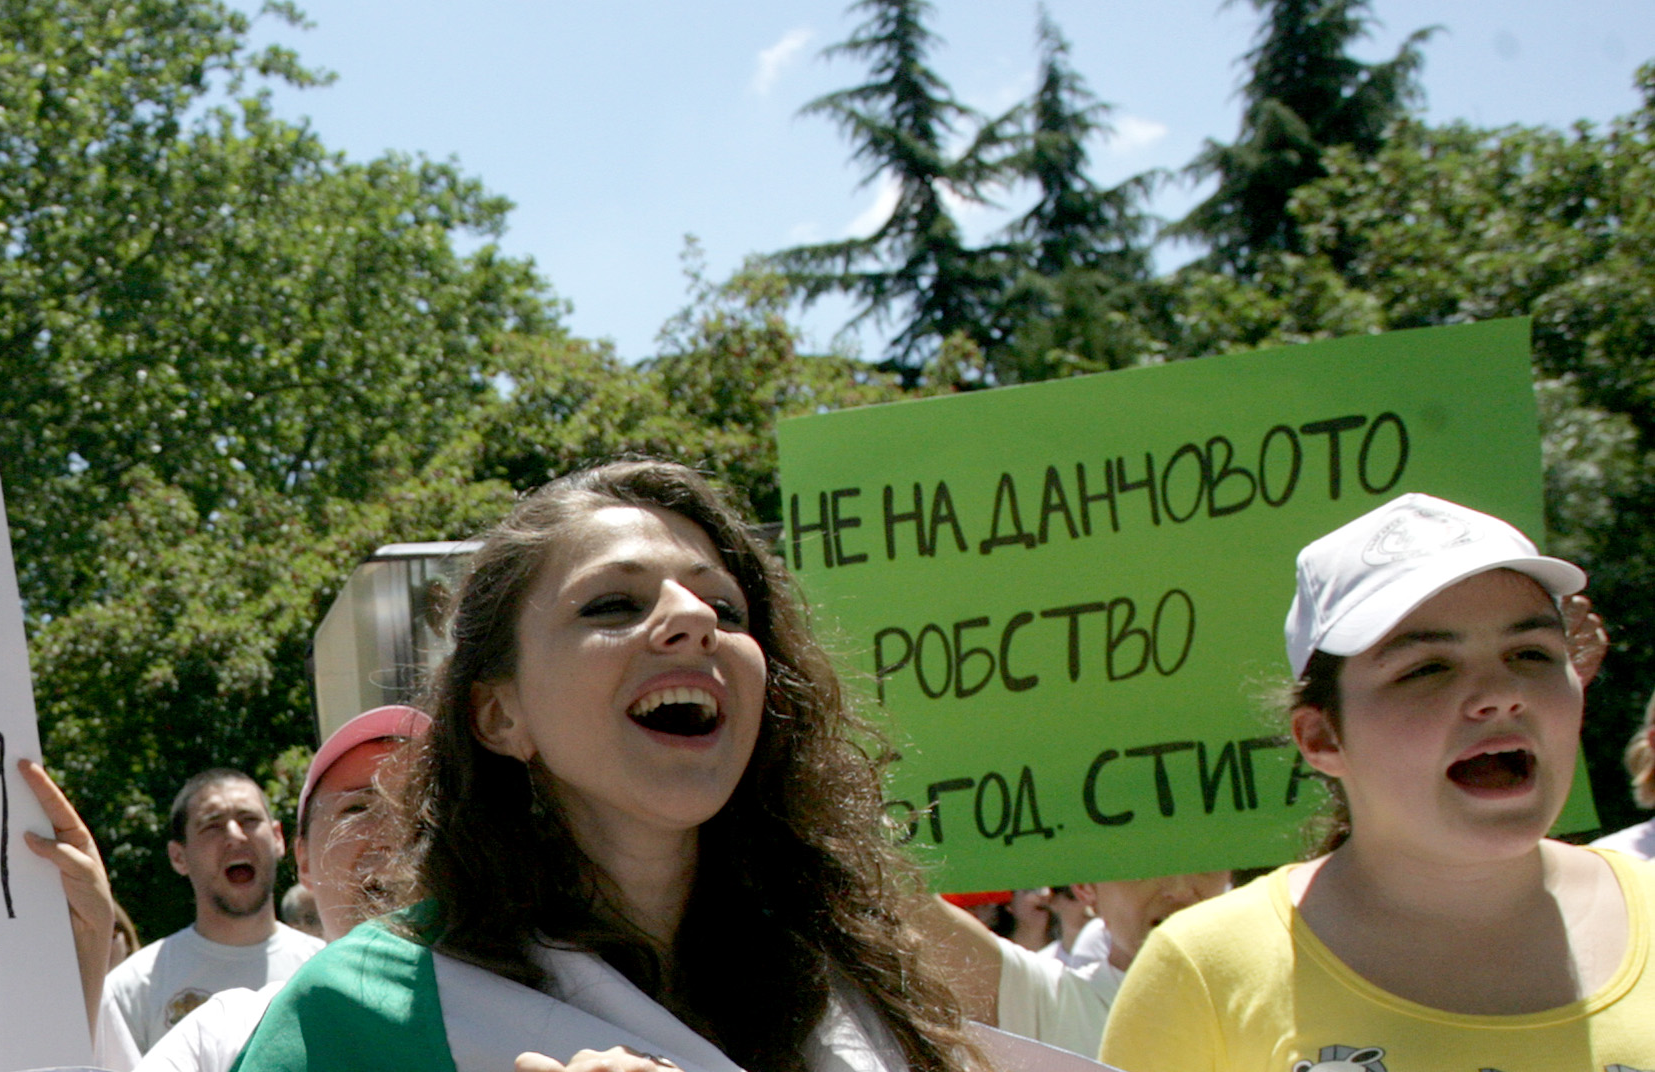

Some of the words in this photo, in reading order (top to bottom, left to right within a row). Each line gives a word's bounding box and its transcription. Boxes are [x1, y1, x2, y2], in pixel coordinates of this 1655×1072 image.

[792, 487, 867, 570] НЕ
[884, 481, 968, 558] НА
[980, 412, 1408, 556] ДАНЧОВОТО
[873, 590, 1196, 706] РОБСТВО
